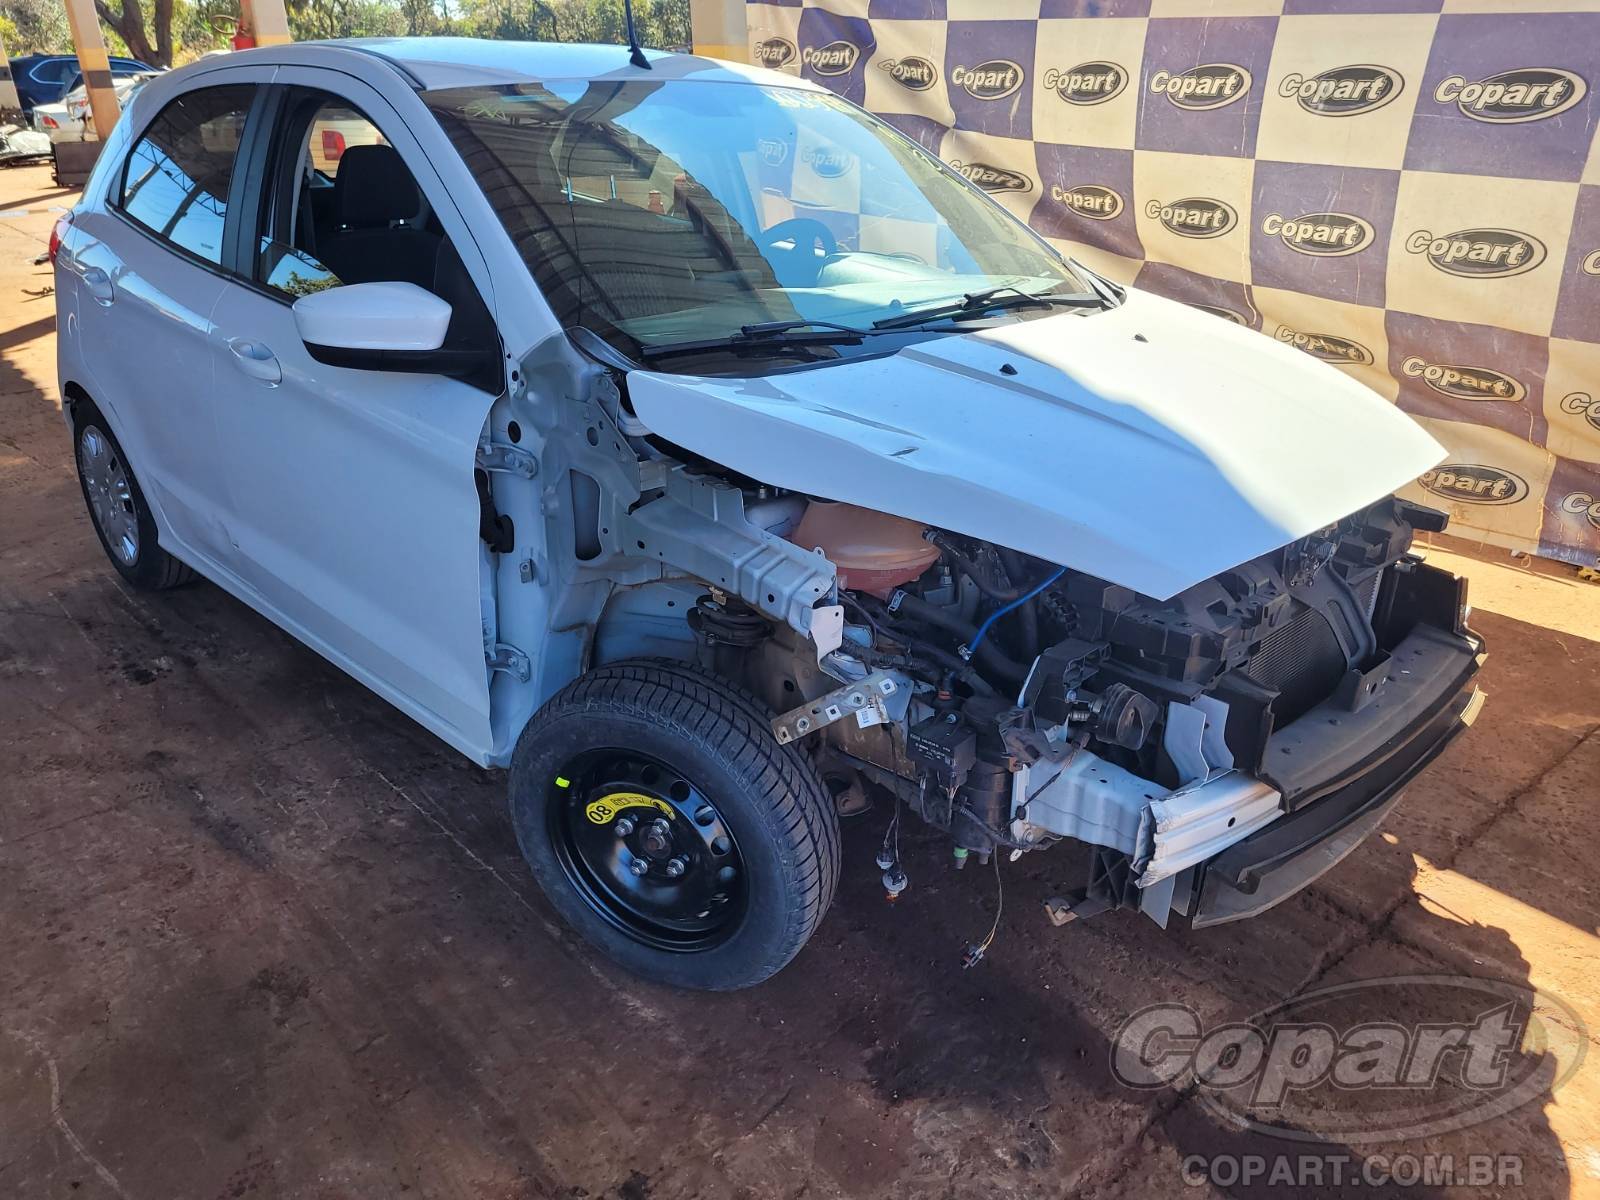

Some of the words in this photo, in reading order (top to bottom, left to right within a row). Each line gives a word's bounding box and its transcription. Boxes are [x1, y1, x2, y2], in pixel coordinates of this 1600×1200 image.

[802, 46, 851, 66] Copart
[877, 58, 931, 82] Copart
[950, 64, 1017, 95] Copart
[1043, 68, 1118, 96] Copart
[1149, 70, 1241, 98] Copart
[1279, 73, 1391, 103] Copart
[1434, 75, 1569, 111] Copart
[1052, 184, 1114, 213] Copart
[1145, 200, 1224, 229] Copart
[1261, 213, 1361, 247] Copart
[1405, 230, 1533, 266] Copart
[1402, 356, 1507, 398] Copart
[1422, 468, 1511, 498] opart
